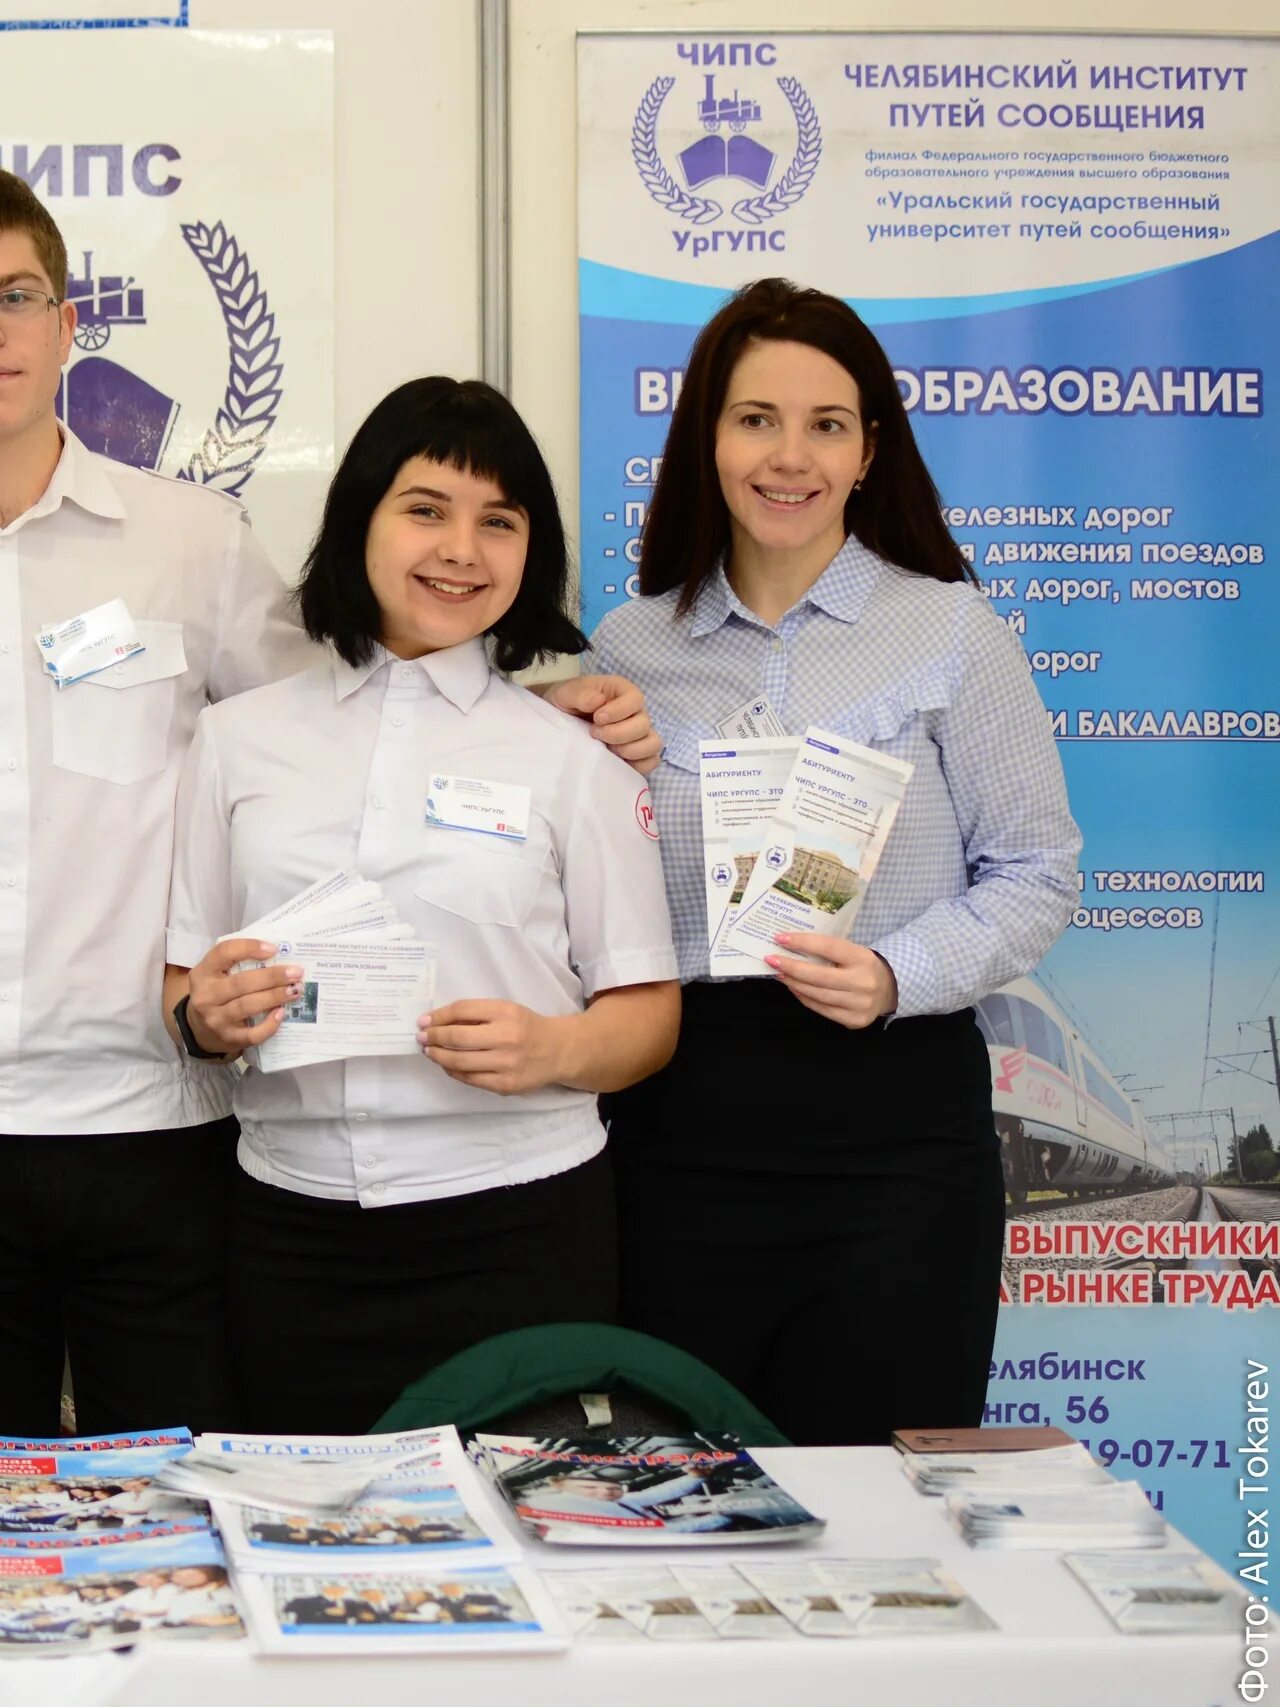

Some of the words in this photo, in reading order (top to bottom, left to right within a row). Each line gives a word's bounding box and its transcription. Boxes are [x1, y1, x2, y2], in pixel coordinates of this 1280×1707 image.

[676, 42, 777, 69] ЧИПС
[844, 59, 1077, 91] ЧЕЛЯБИНСКИЙ
[1090, 65, 1248, 92] ИНСТИТУТ
[889, 99, 985, 129] ПУТЕЙ
[995, 104, 1205, 133] СООБЩЕНИЯ
[865, 149, 917, 164] филиал
[922, 150, 1019, 164] Федерального
[1023, 151, 1144, 164] государственного
[1149, 150, 1229, 164] бюджетного
[865, 166, 989, 180] образовательного
[994, 167, 1074, 181] учреждения
[1079, 168, 1137, 180] высшего
[1141, 167, 1230, 181] образования
[876, 190, 1013, 215] «Уральский
[1021, 190, 1220, 215] государственный
[672, 230, 786, 256] УрГУПС
[866, 221, 1011, 243] университет
[1019, 220, 1082, 242] путей
[1090, 220, 1231, 242] сообщения»
[892, 369, 1261, 414] ОБРАЗОВАНИЕ
[1084, 506, 1172, 532] дорог
[984, 542, 1131, 566] движения
[1141, 542, 1264, 566] поездов
[1025, 576, 1120, 605] дорог,
[1130, 578, 1240, 600] мостов
[1026, 650, 1101, 678] орог
[1078, 711, 1280, 737] БАКАЛАВРОВ
[706, 770, 761, 779] АБИТУРИЕНТУ
[802, 758, 855, 782] АБИТУРИЕНТУ
[707, 790, 729, 798] ЧИПС
[730, 789, 760, 797] УРГУПС
[768, 788, 784, 796] ЭТО
[795, 776, 816, 789] ЧИПС
[817, 785, 846, 800] УРГУПС
[1094, 872, 1264, 892] технологии
[1067, 908, 1202, 932] оцессов
[1010, 1225, 1279, 1256] ВЫПУСКНИКИ
[1024, 1274, 1150, 1303] РЫНКЕ
[1164, 1273, 1280, 1309] ТРУДА
[1065, 1396, 1110, 1424] 56
